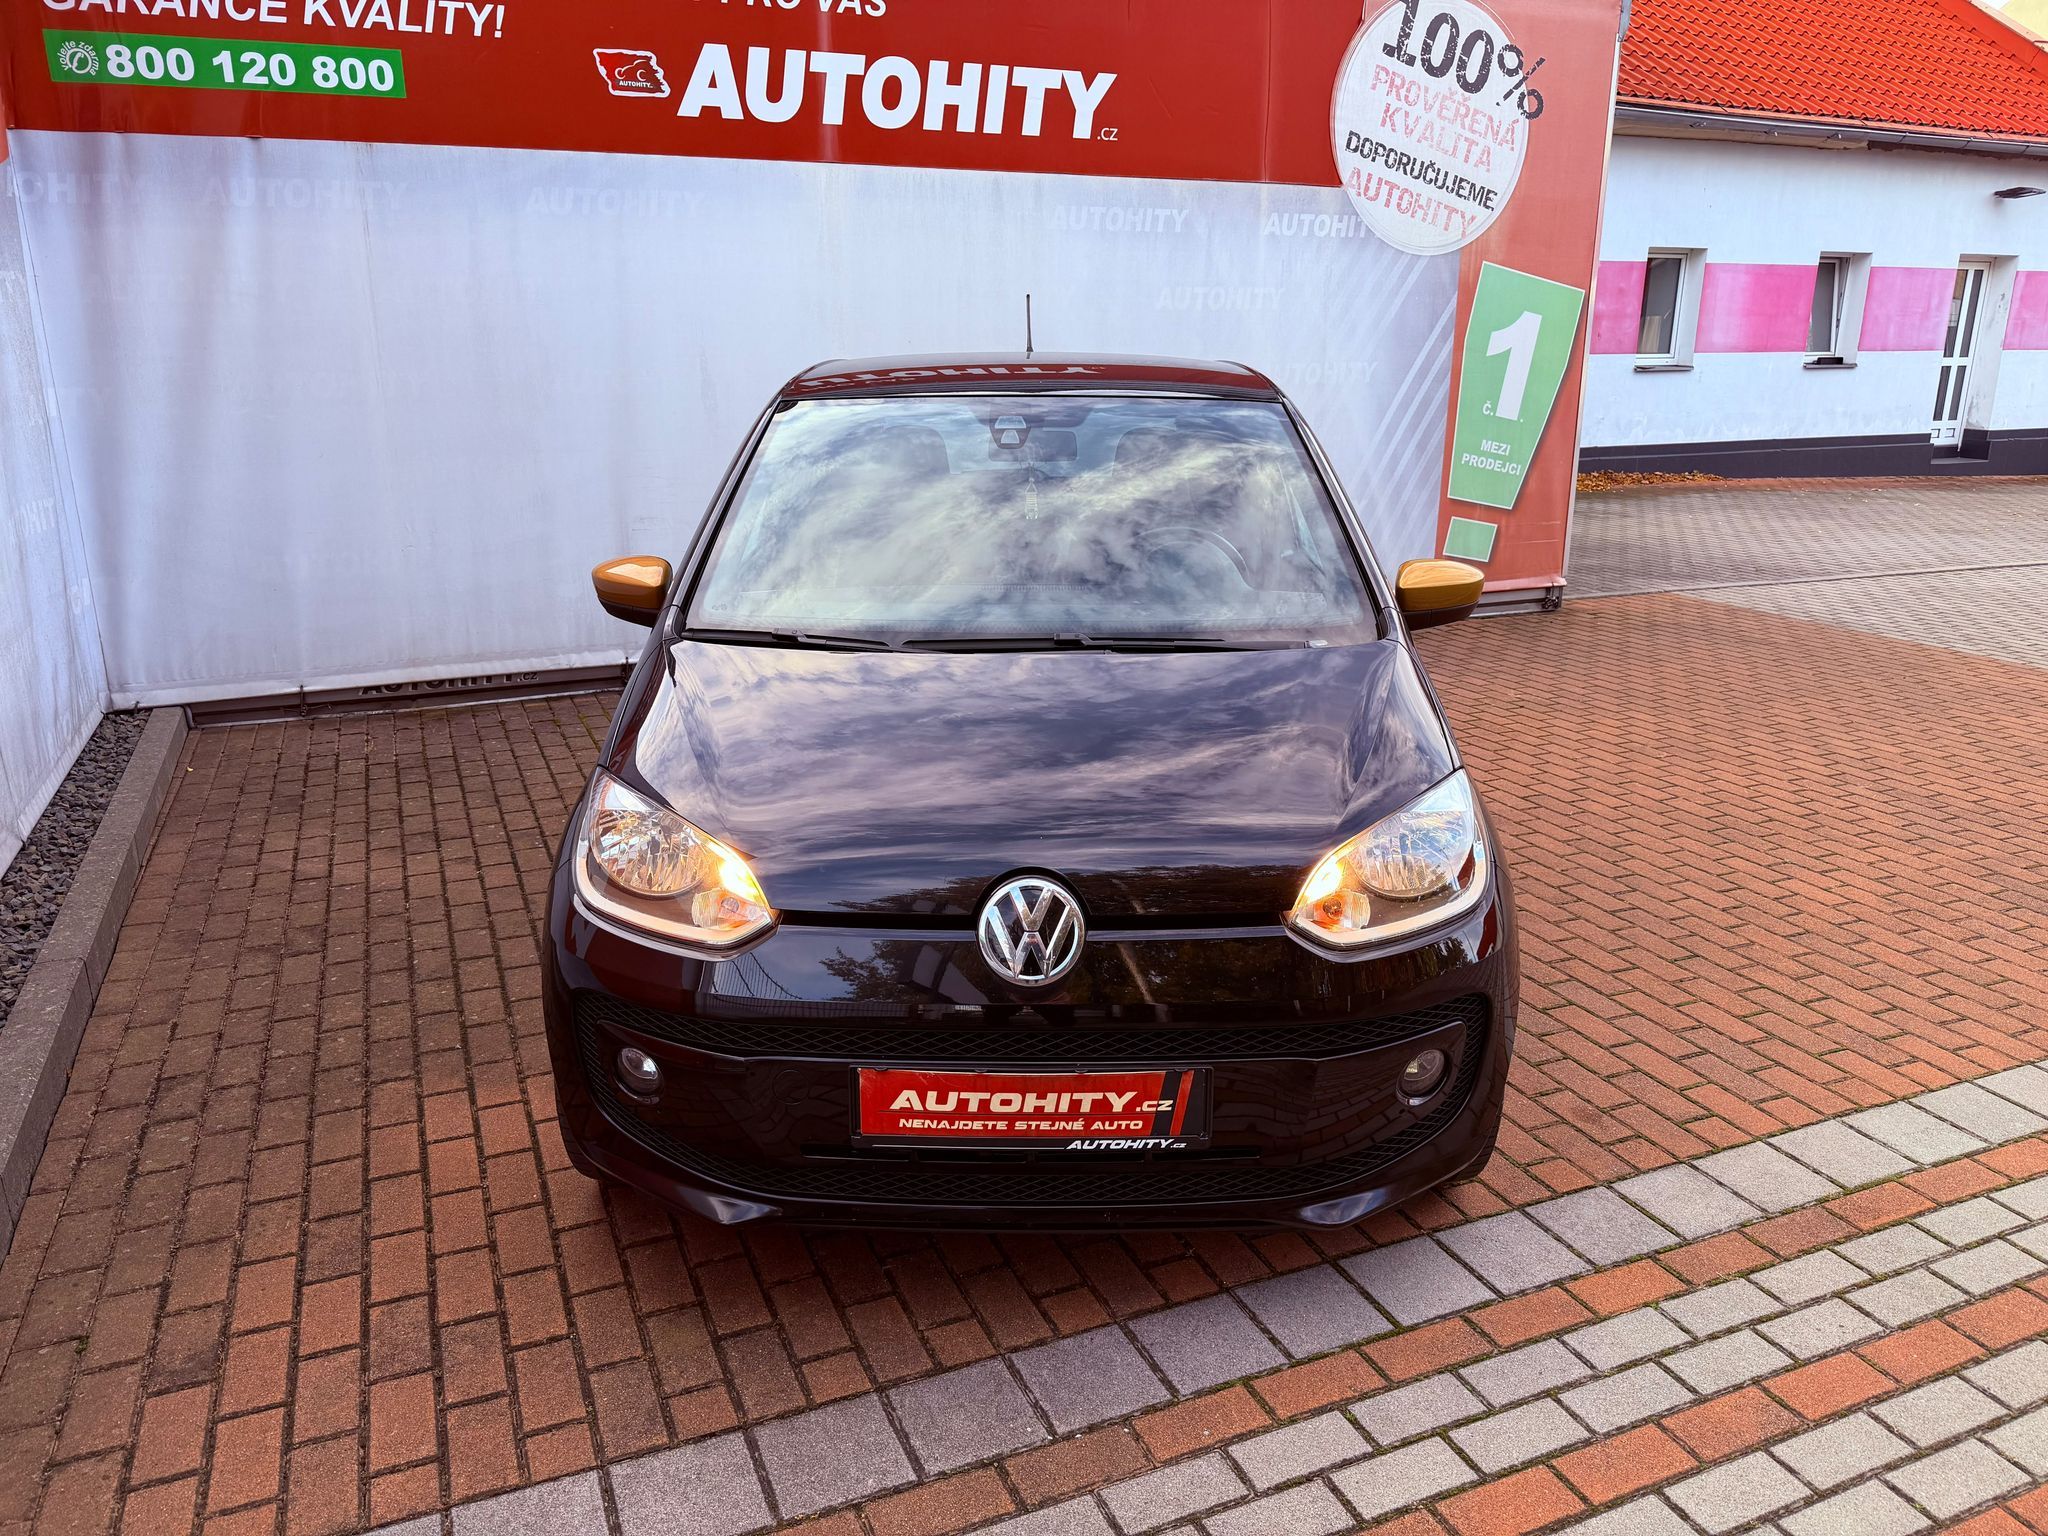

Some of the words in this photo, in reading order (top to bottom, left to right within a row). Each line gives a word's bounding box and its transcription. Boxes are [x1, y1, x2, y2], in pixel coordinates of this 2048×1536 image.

[303, 0, 505, 38] KVALITY!
[105, 44, 195, 81] 800
[212, 50, 296, 86] 120
[312, 56, 394, 91] 800
[1382, 0, 1546, 120] 100%
[1369, 64, 1519, 151] PROVĚŘENÁ
[1379, 103, 1493, 173] KVALITA
[1345, 130, 1498, 212] DOPORUČUJEME
[524, 187, 706, 218] AUTOHITY
[1048, 205, 1191, 233] AUTOHITY
[1346, 167, 1477, 239] AUTOHITY
[1155, 286, 1285, 311] AUTOHITY
[1461, 453, 1521, 475] PRODEJCI
[1481, 439, 1511, 456] MEZI
[899, 1118, 1008, 1130] NENAJDETE
[1014, 1118, 1084, 1130] STEJNÉ
[1090, 1120, 1143, 1130] AUTO
